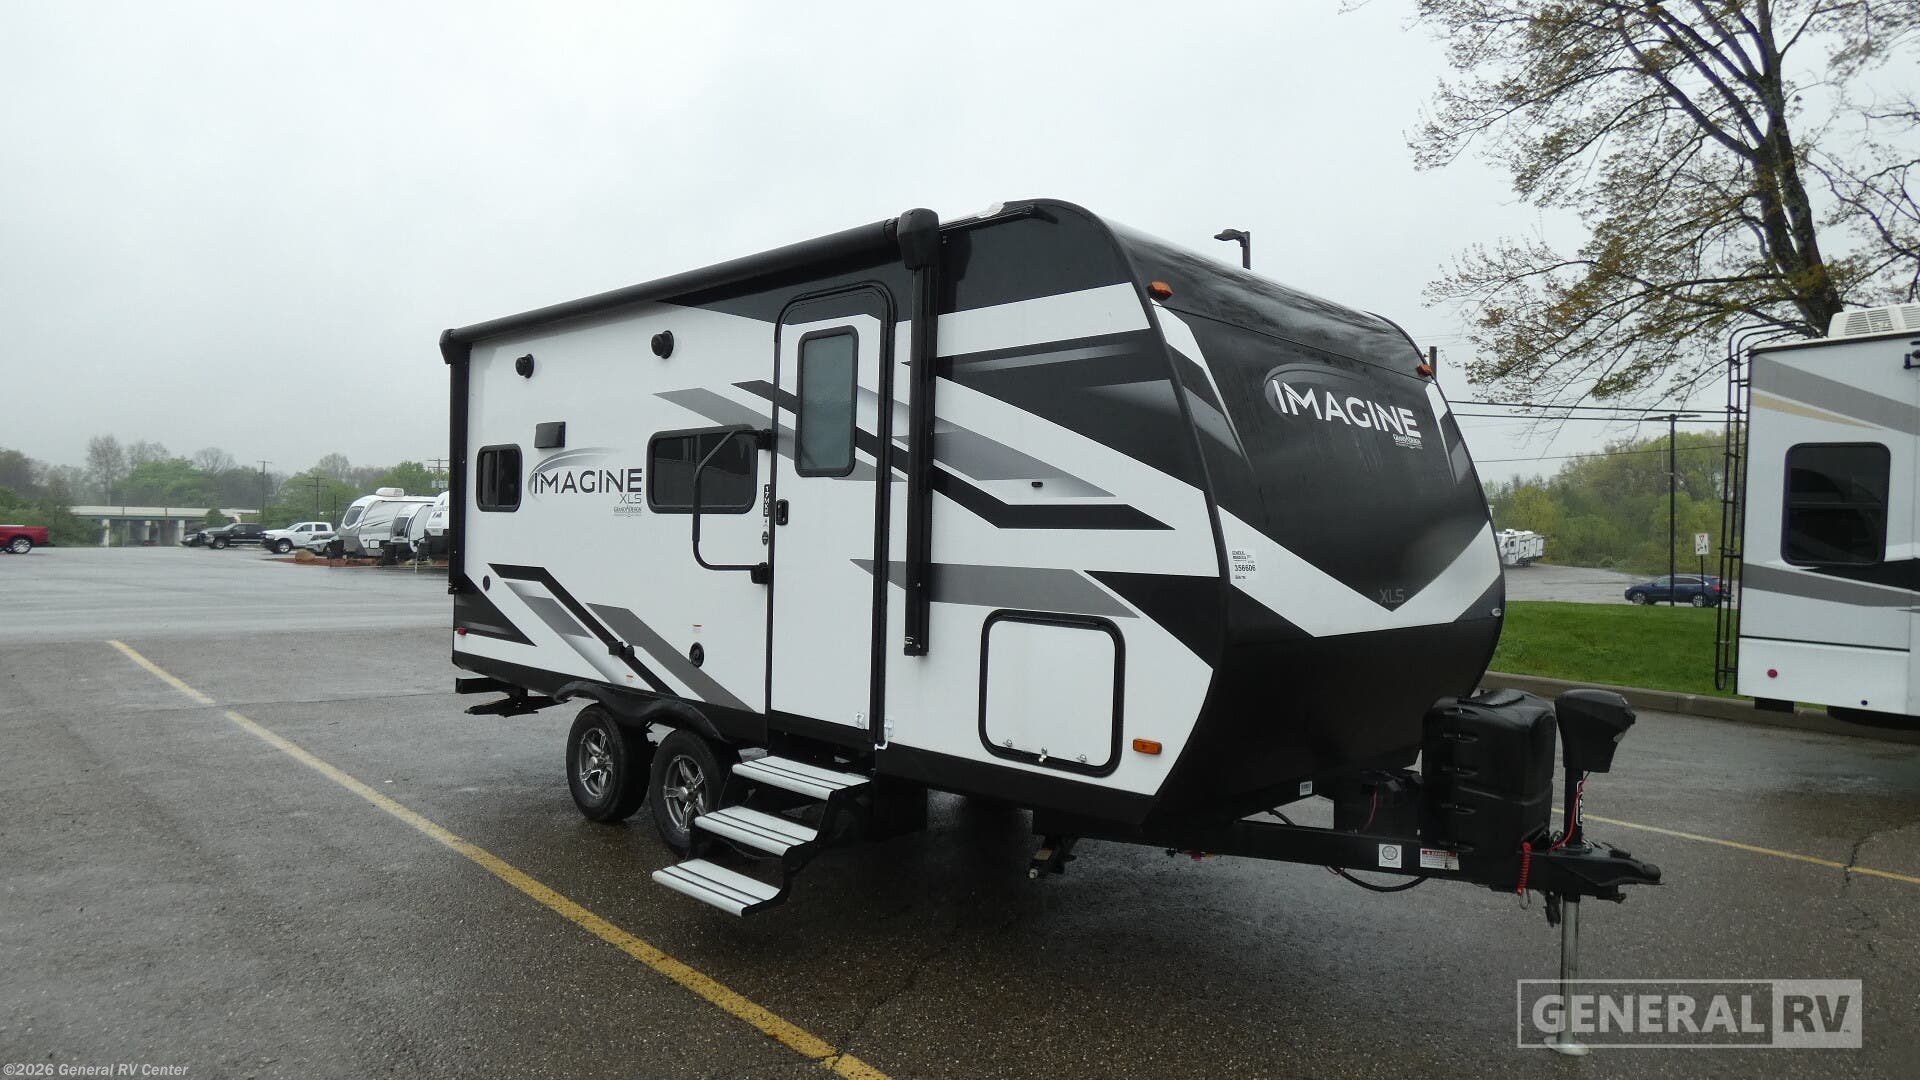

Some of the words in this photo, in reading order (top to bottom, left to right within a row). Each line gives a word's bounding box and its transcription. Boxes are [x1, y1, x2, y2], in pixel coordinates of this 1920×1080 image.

[1272, 379, 1422, 438] IMAGINE
[534, 468, 642, 494] IMAGINE
[619, 493, 642, 504] XLS
[1379, 588, 1405, 604] XLS
